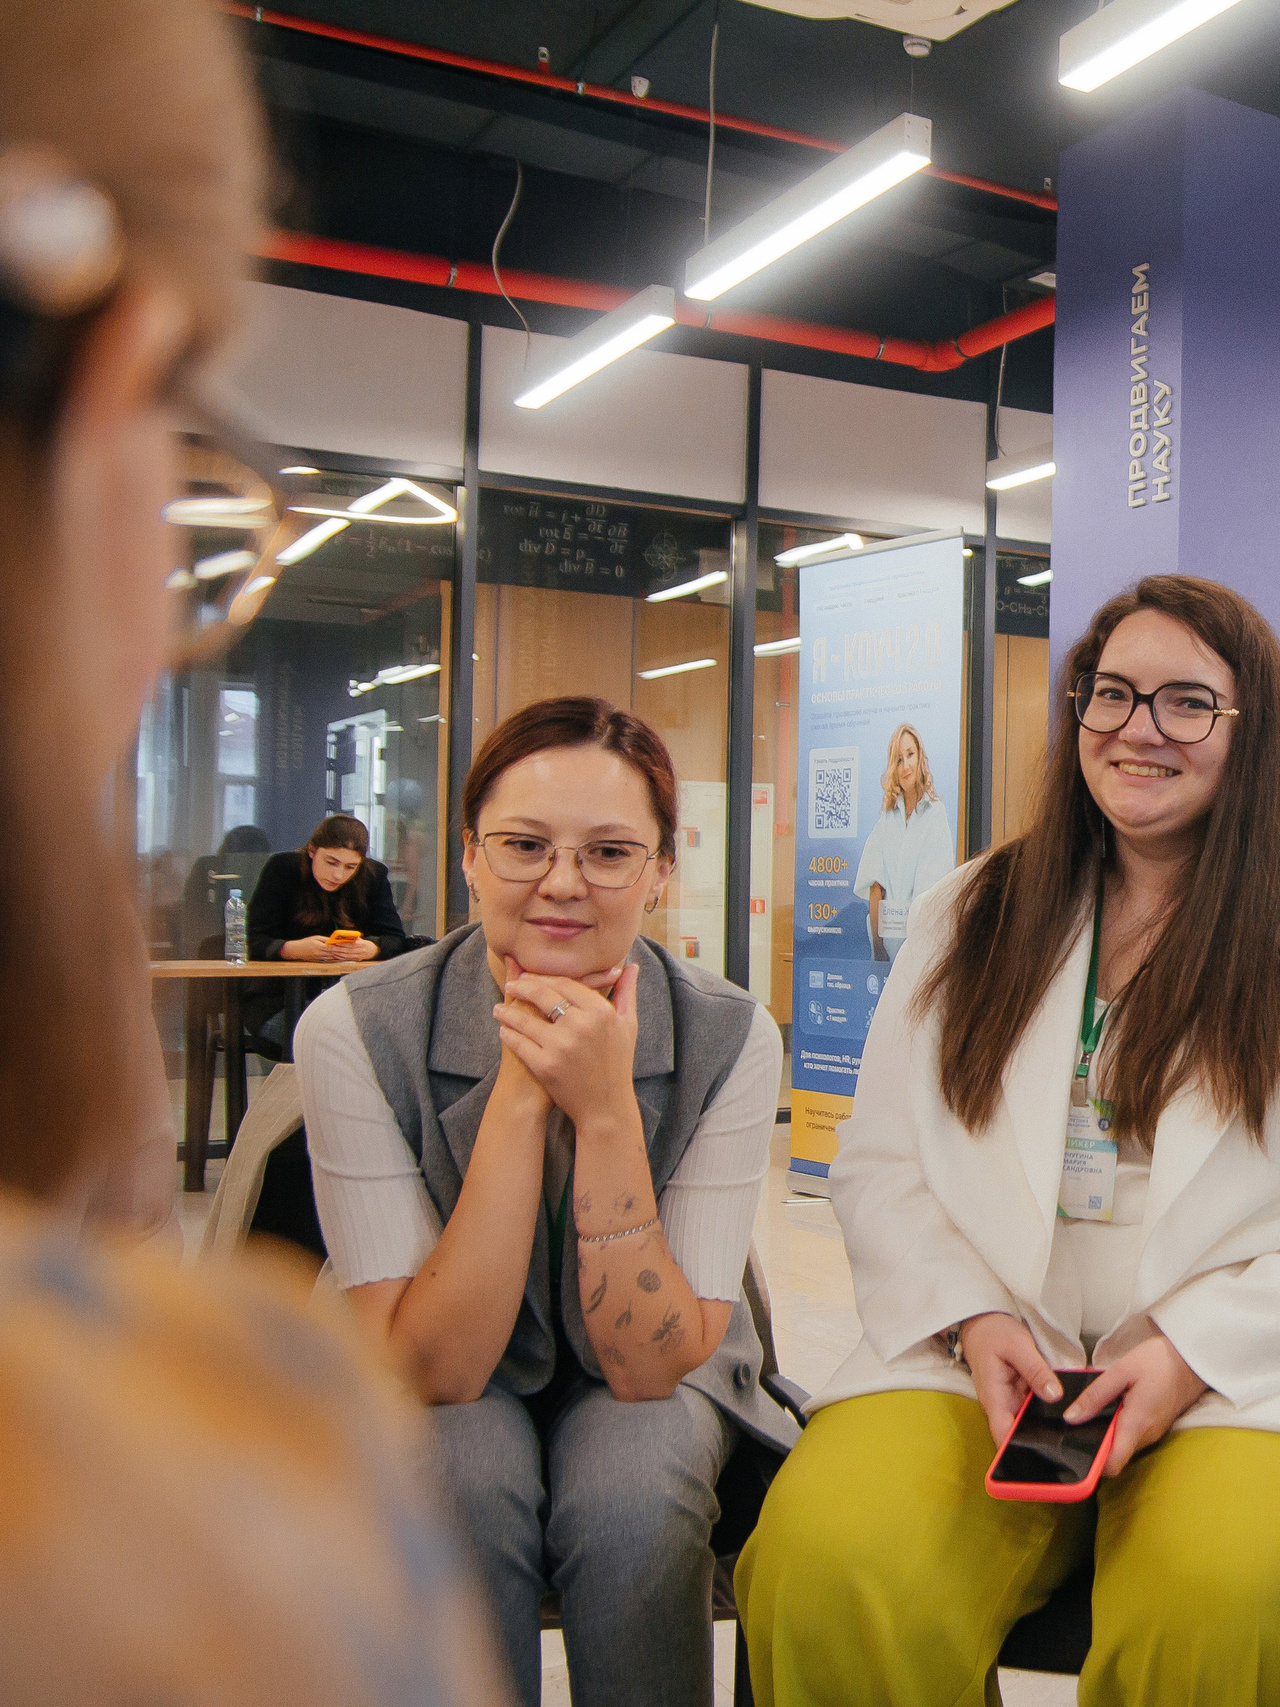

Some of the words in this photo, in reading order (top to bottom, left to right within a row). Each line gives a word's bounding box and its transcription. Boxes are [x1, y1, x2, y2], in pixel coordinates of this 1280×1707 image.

[1128, 262, 1150, 508] ПРОДВИГАЕМ
[1152, 380, 1172, 503] НАУКУ
[813, 637, 827, 684] Я
[844, 625, 902, 681] КОУЧ
[811, 691, 845, 704] ОСНОВЫ
[808, 856, 848, 874] 4800+
[808, 902, 839, 920] 130+
[882, 905, 904, 917] Елена
[805, 1106, 834, 1119] Научитесь
